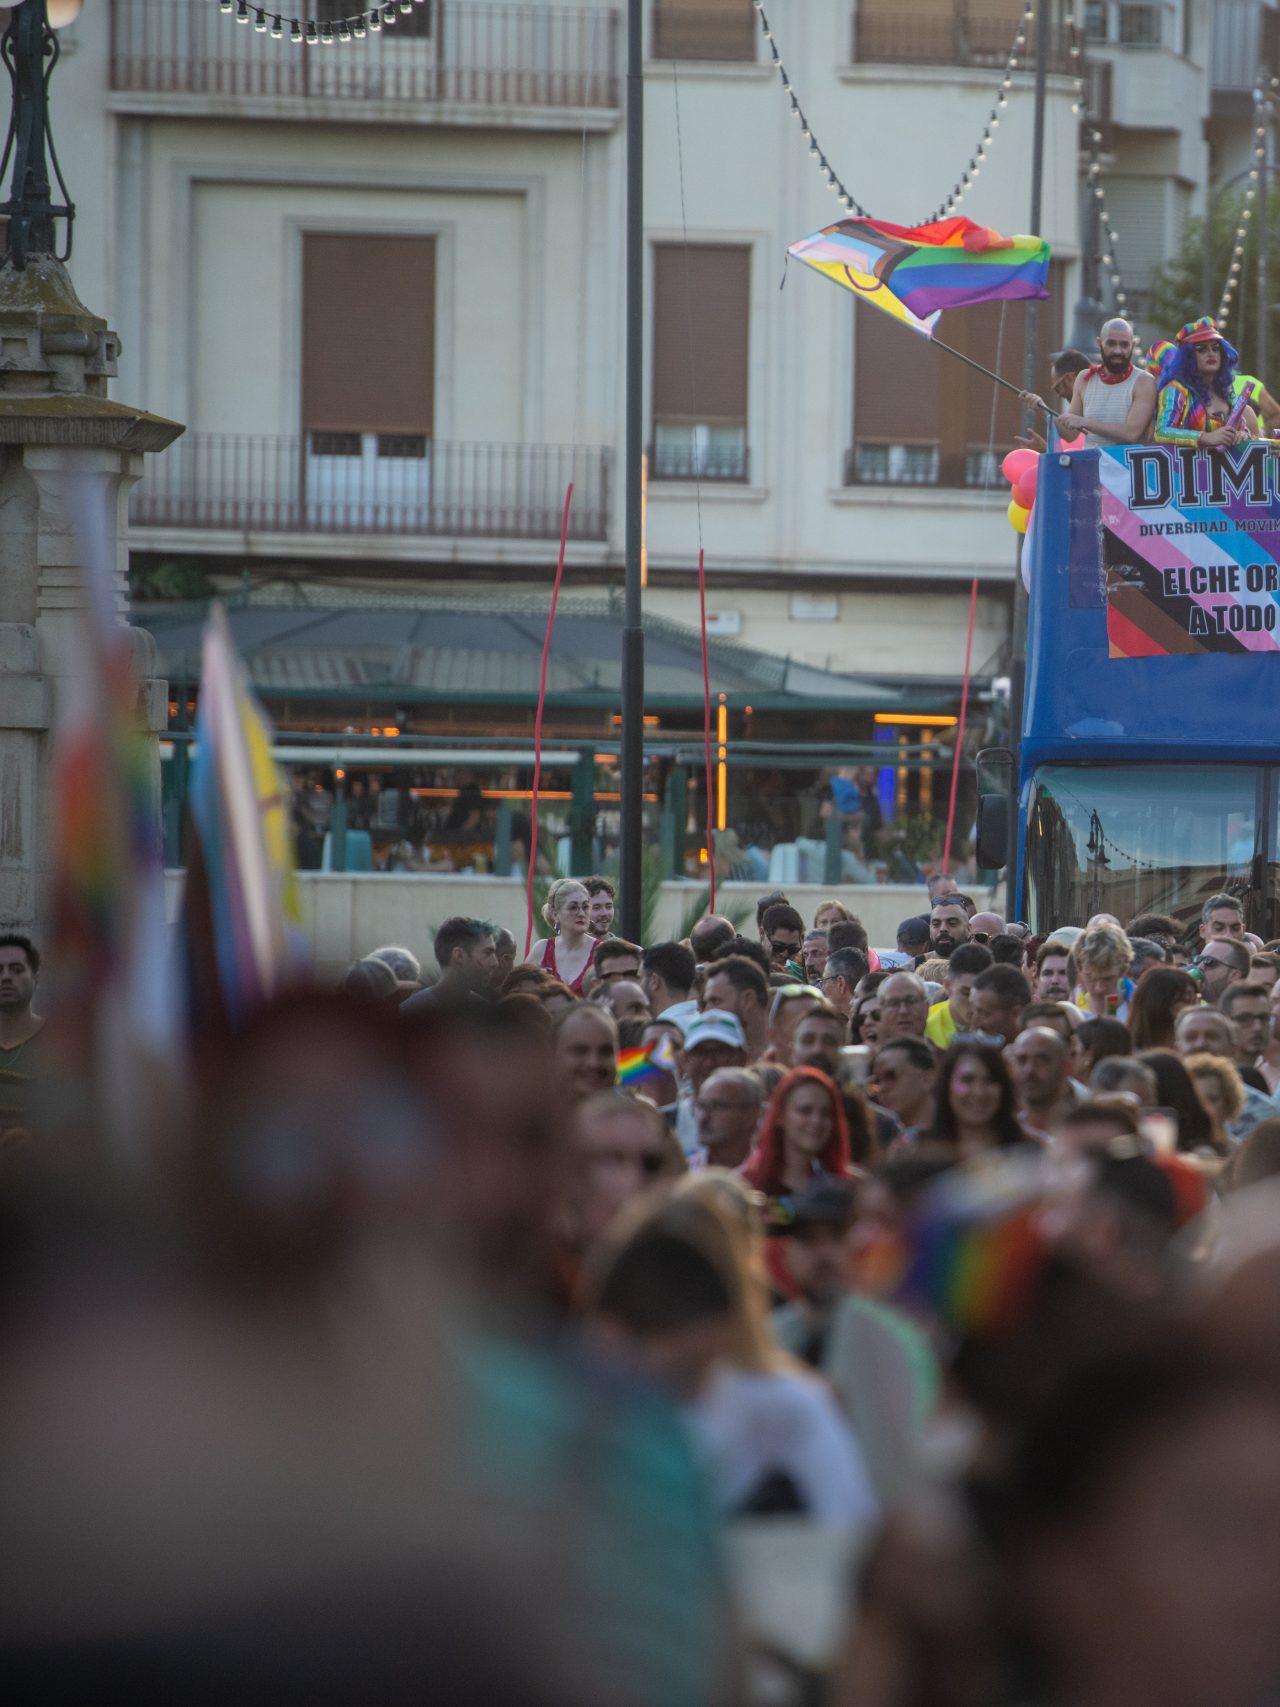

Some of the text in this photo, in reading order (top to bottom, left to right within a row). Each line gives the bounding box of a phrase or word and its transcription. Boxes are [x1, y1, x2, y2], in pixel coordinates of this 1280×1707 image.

[1163, 564, 1240, 596] ELCHE
[1189, 606, 1208, 635] A
[1213, 604, 1275, 633] TODO
